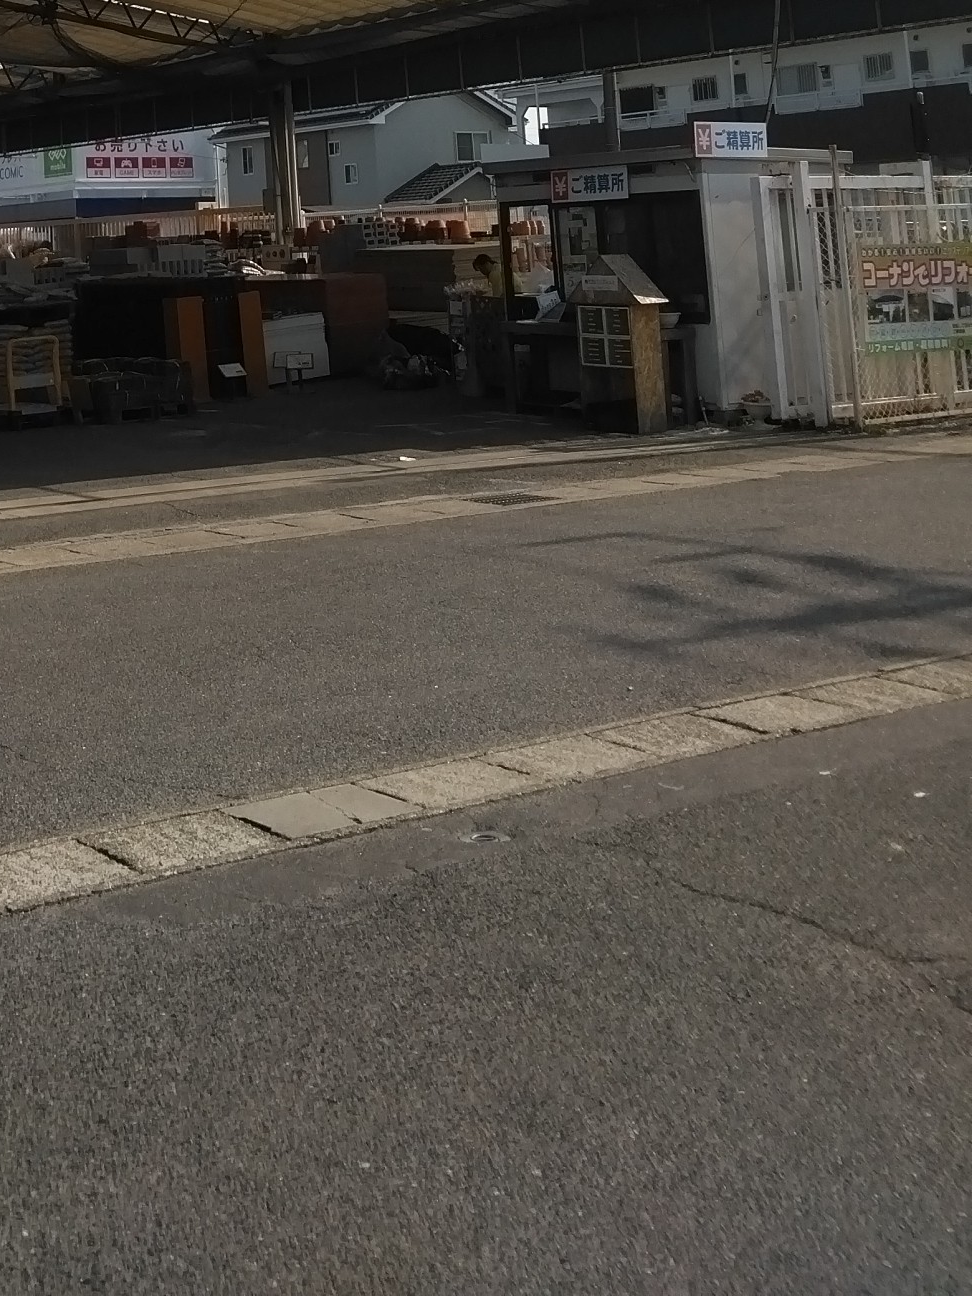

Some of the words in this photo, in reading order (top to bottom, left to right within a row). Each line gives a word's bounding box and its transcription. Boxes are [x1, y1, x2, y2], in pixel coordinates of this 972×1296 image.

[715, 129, 763, 151] ご精算所
[571, 172, 624, 195] ご精算所
[862, 260, 972, 286] コーナンでリフォ
